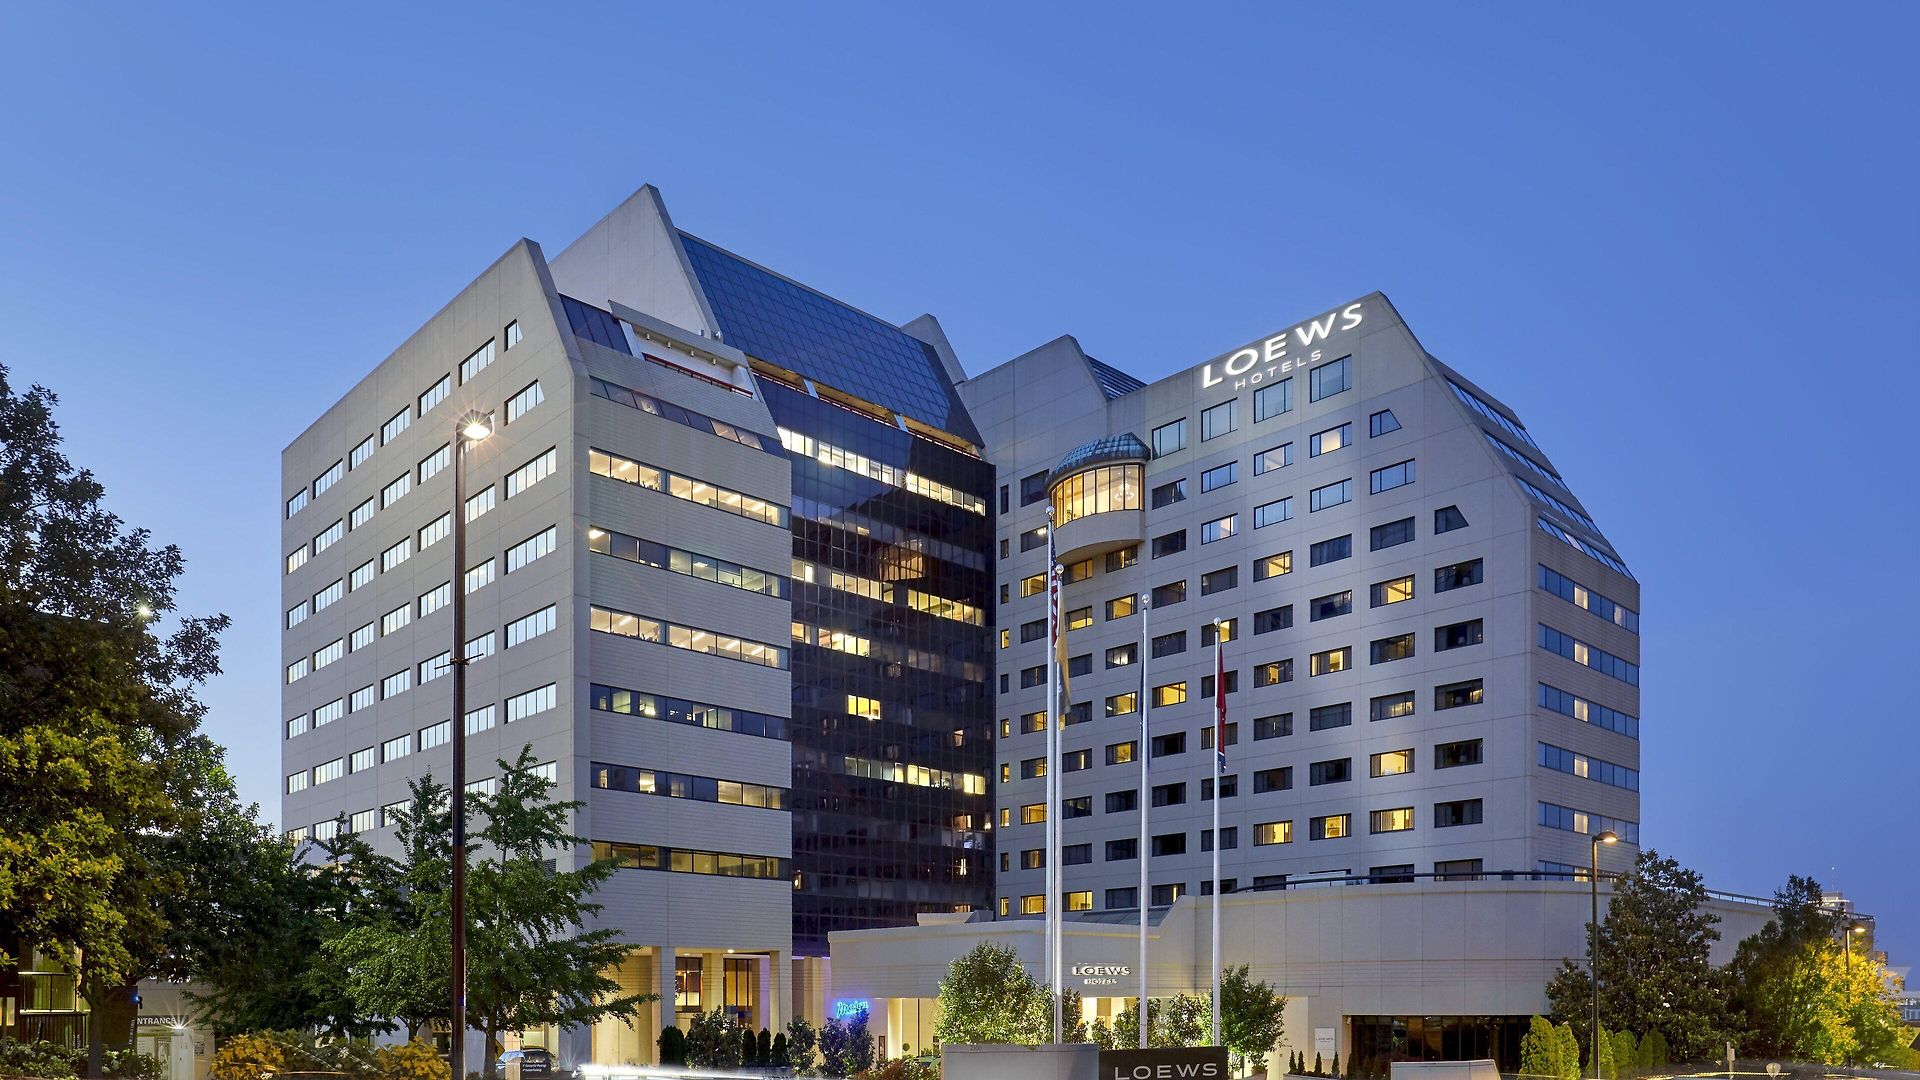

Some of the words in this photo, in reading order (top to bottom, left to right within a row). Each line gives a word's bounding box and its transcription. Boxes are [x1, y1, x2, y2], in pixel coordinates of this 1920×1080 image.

[1203, 303, 1363, 388] LOEWS
[1235, 350, 1322, 391] HOTELS
[1073, 966, 1131, 976] LOEWS
[137, 1017, 176, 1025] NTRANCE
[1114, 1062, 1218, 1080] LOEWS
